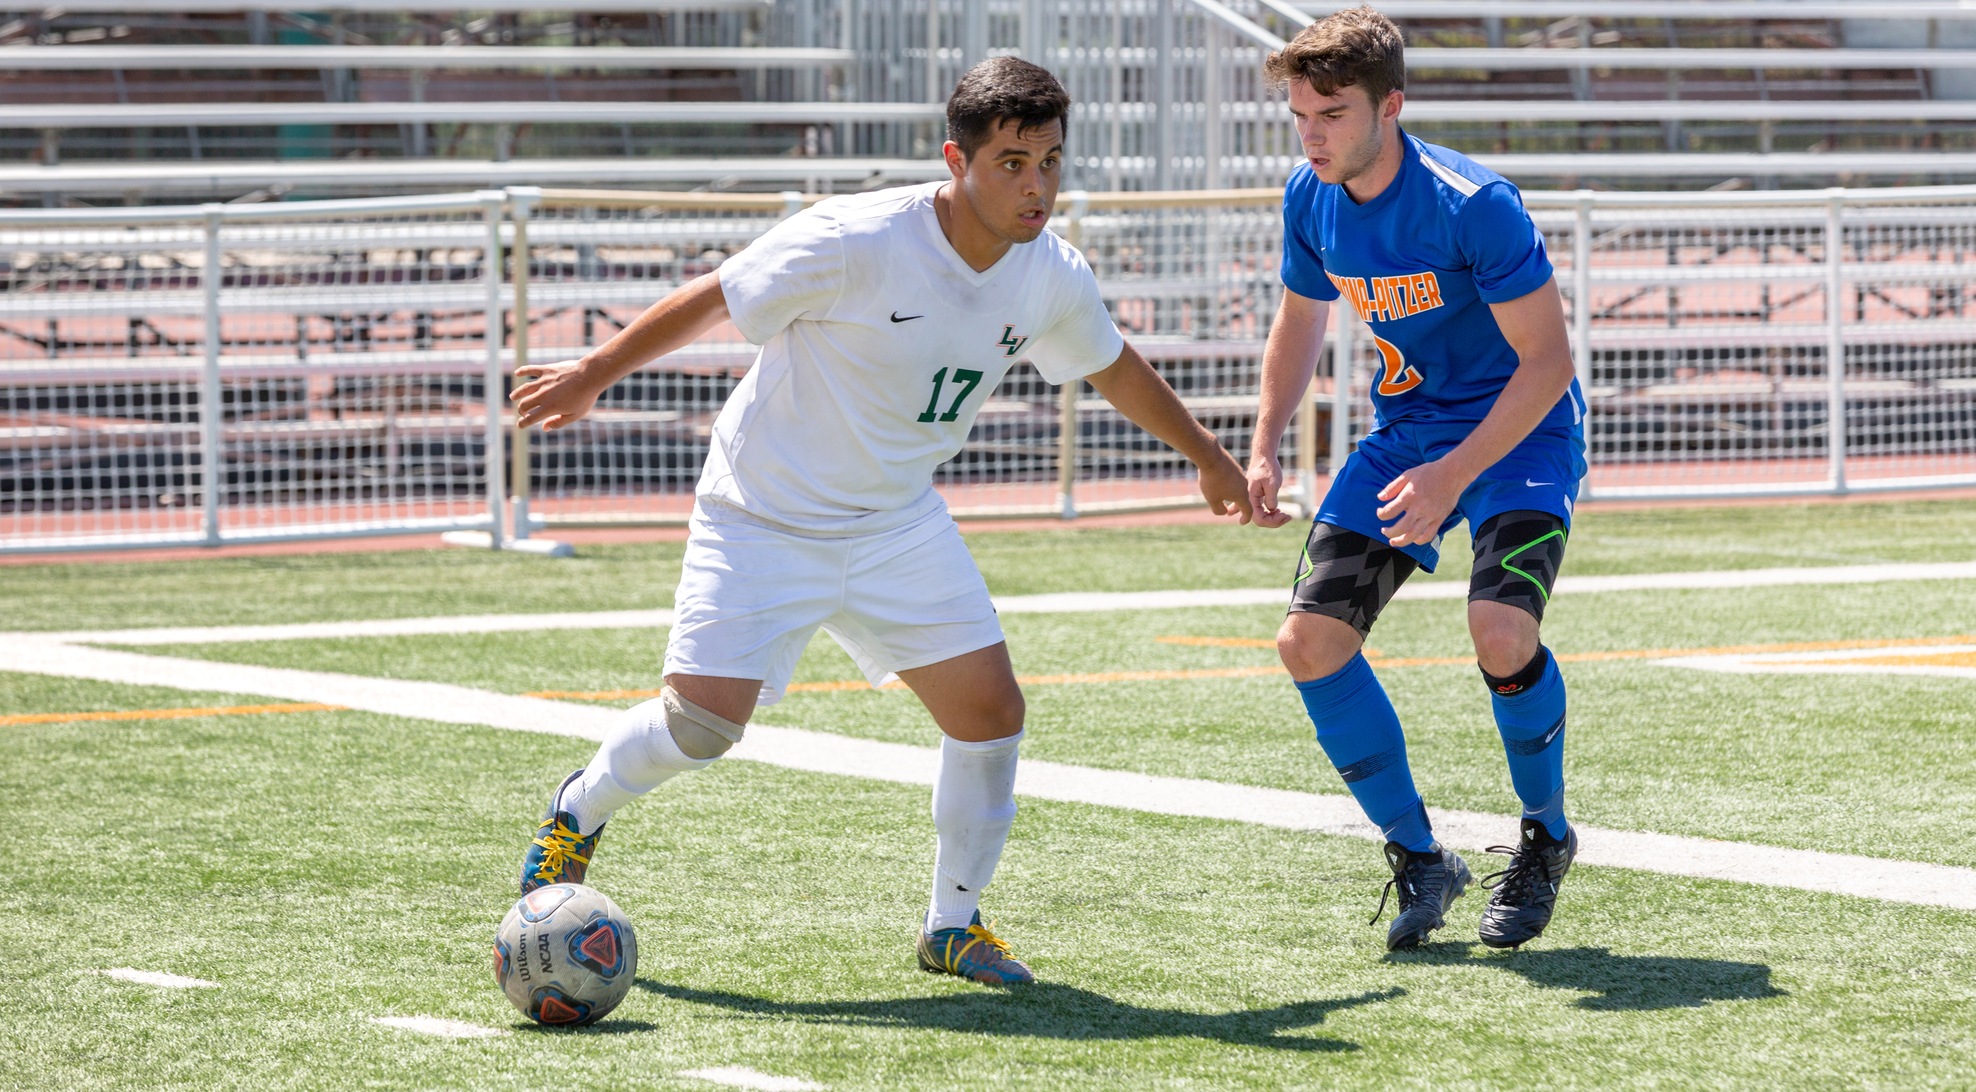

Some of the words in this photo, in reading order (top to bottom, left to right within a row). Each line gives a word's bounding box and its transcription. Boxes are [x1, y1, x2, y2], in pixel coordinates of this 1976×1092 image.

[996, 324, 1029, 358] LV
[1374, 334, 1424, 396] 2
[917, 367, 984, 422] 17
[517, 933, 531, 982] Wilson
[538, 933, 553, 974] NCAA
